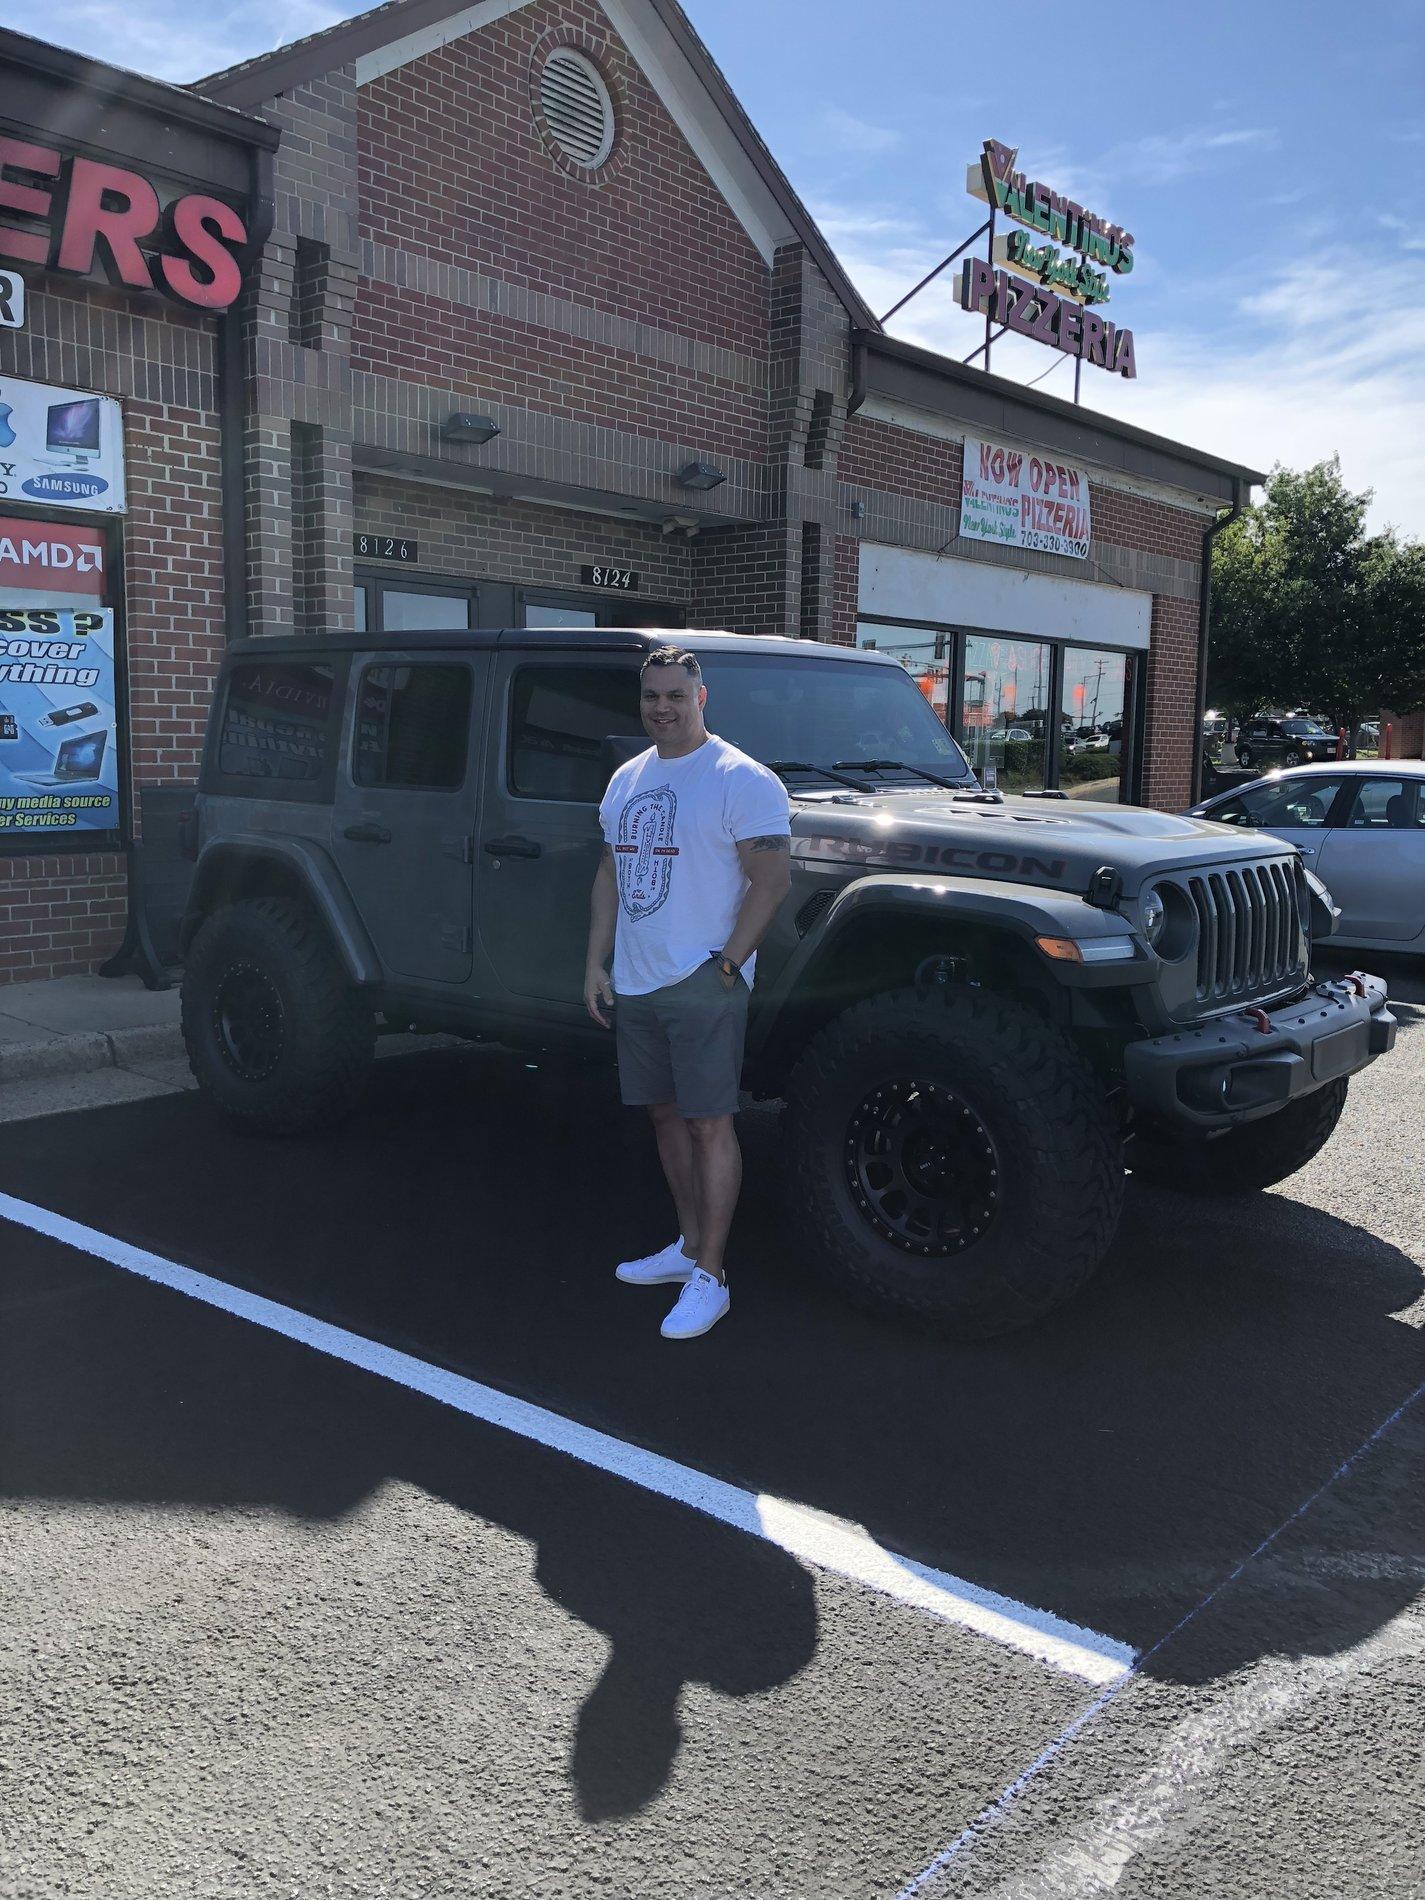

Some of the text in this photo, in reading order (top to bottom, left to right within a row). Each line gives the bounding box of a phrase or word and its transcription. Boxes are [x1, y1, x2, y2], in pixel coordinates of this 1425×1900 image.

[963, 257, 1137, 379] PIZZERIA
[980, 443, 1081, 502] NOW OPEN
[33, 477, 99, 495] SAMSUNG
[1021, 493, 1089, 541] PIZZERIA
[0, 537, 74, 567] AMD
[360, 536, 407, 558] 8126
[593, 566, 631, 588] 8124
[17, 795, 61, 809] media
[63, 795, 111, 808] source
[15, 812, 77, 827] Services
[631, 805, 647, 840] BURNING
